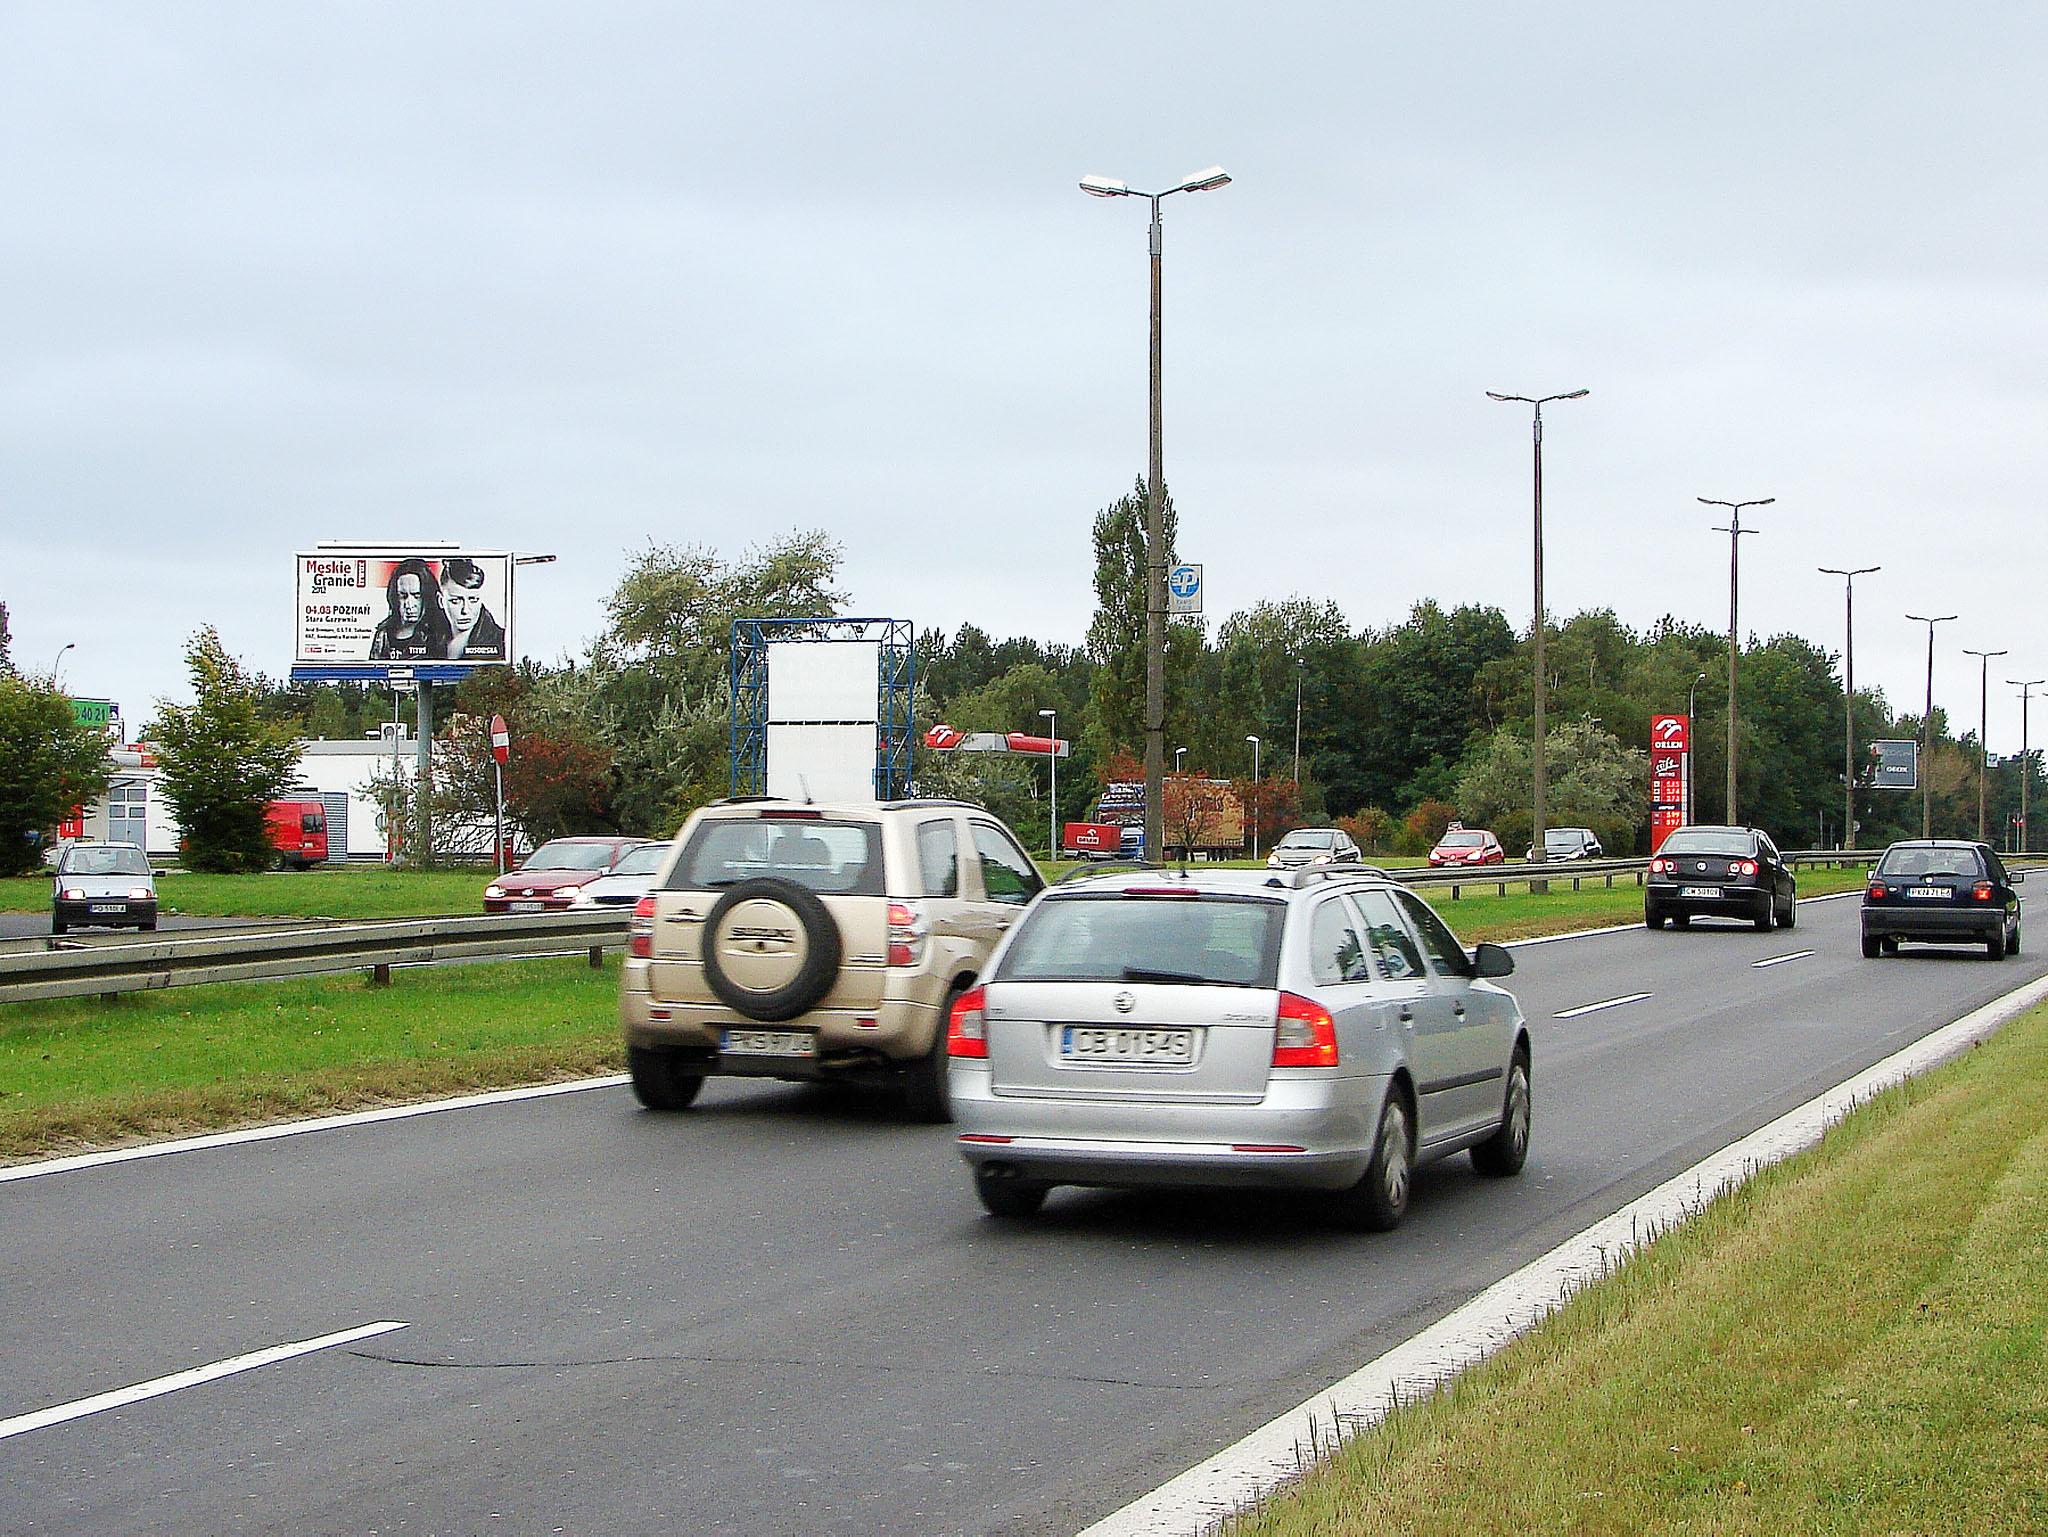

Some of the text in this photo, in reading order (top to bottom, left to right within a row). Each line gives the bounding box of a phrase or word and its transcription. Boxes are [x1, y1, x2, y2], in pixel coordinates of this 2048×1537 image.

[314, 574, 355, 587] Granie
[332, 604, 371, 615] POZNAŃ
[82, 706, 92, 721] 40
[95, 707, 105, 721] 21
[1654, 741, 1683, 749] ORLEN
